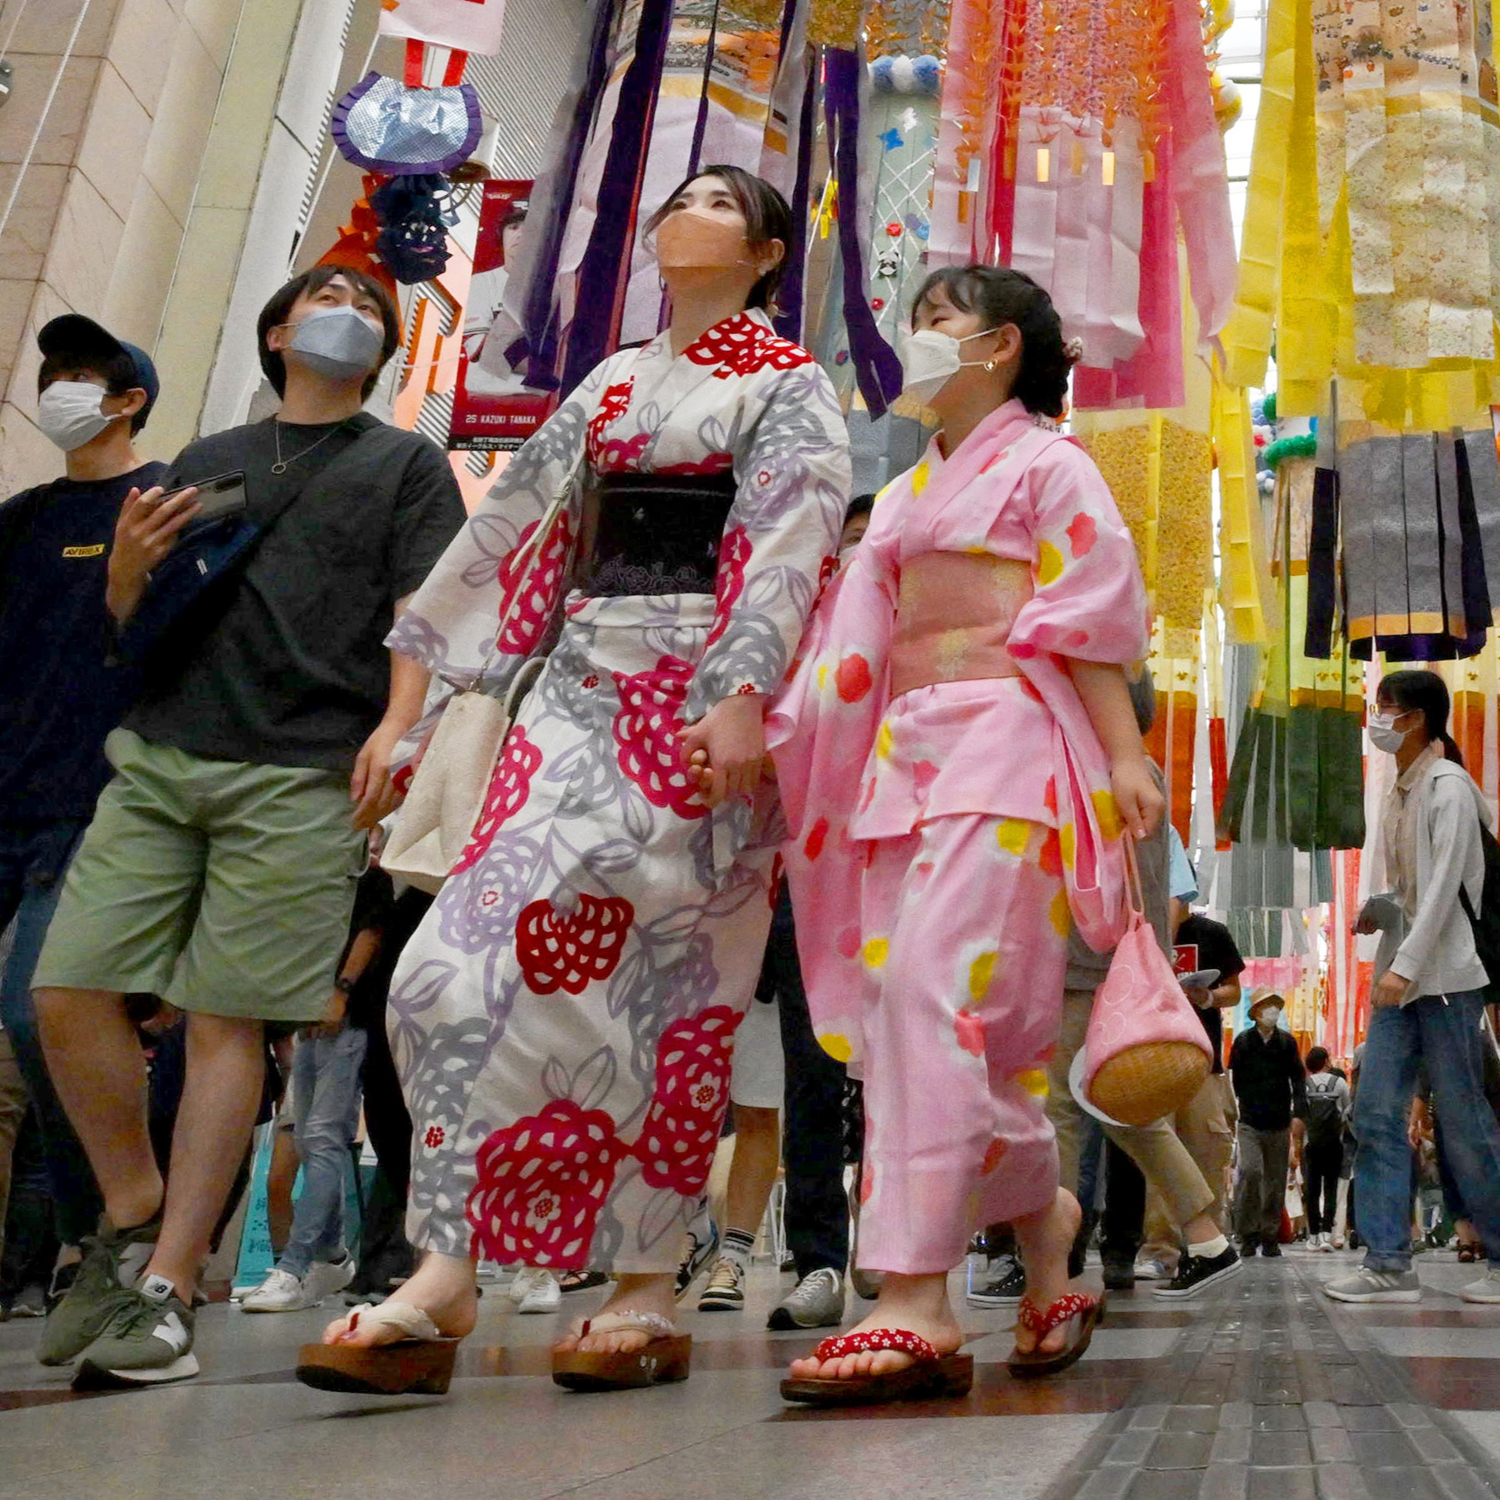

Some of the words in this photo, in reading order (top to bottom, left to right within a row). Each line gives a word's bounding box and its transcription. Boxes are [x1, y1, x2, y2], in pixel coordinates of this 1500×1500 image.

[465, 414, 478, 424] 25
[480, 415, 506, 424] KAZUKI
[509, 415, 537, 425] TANAKA
